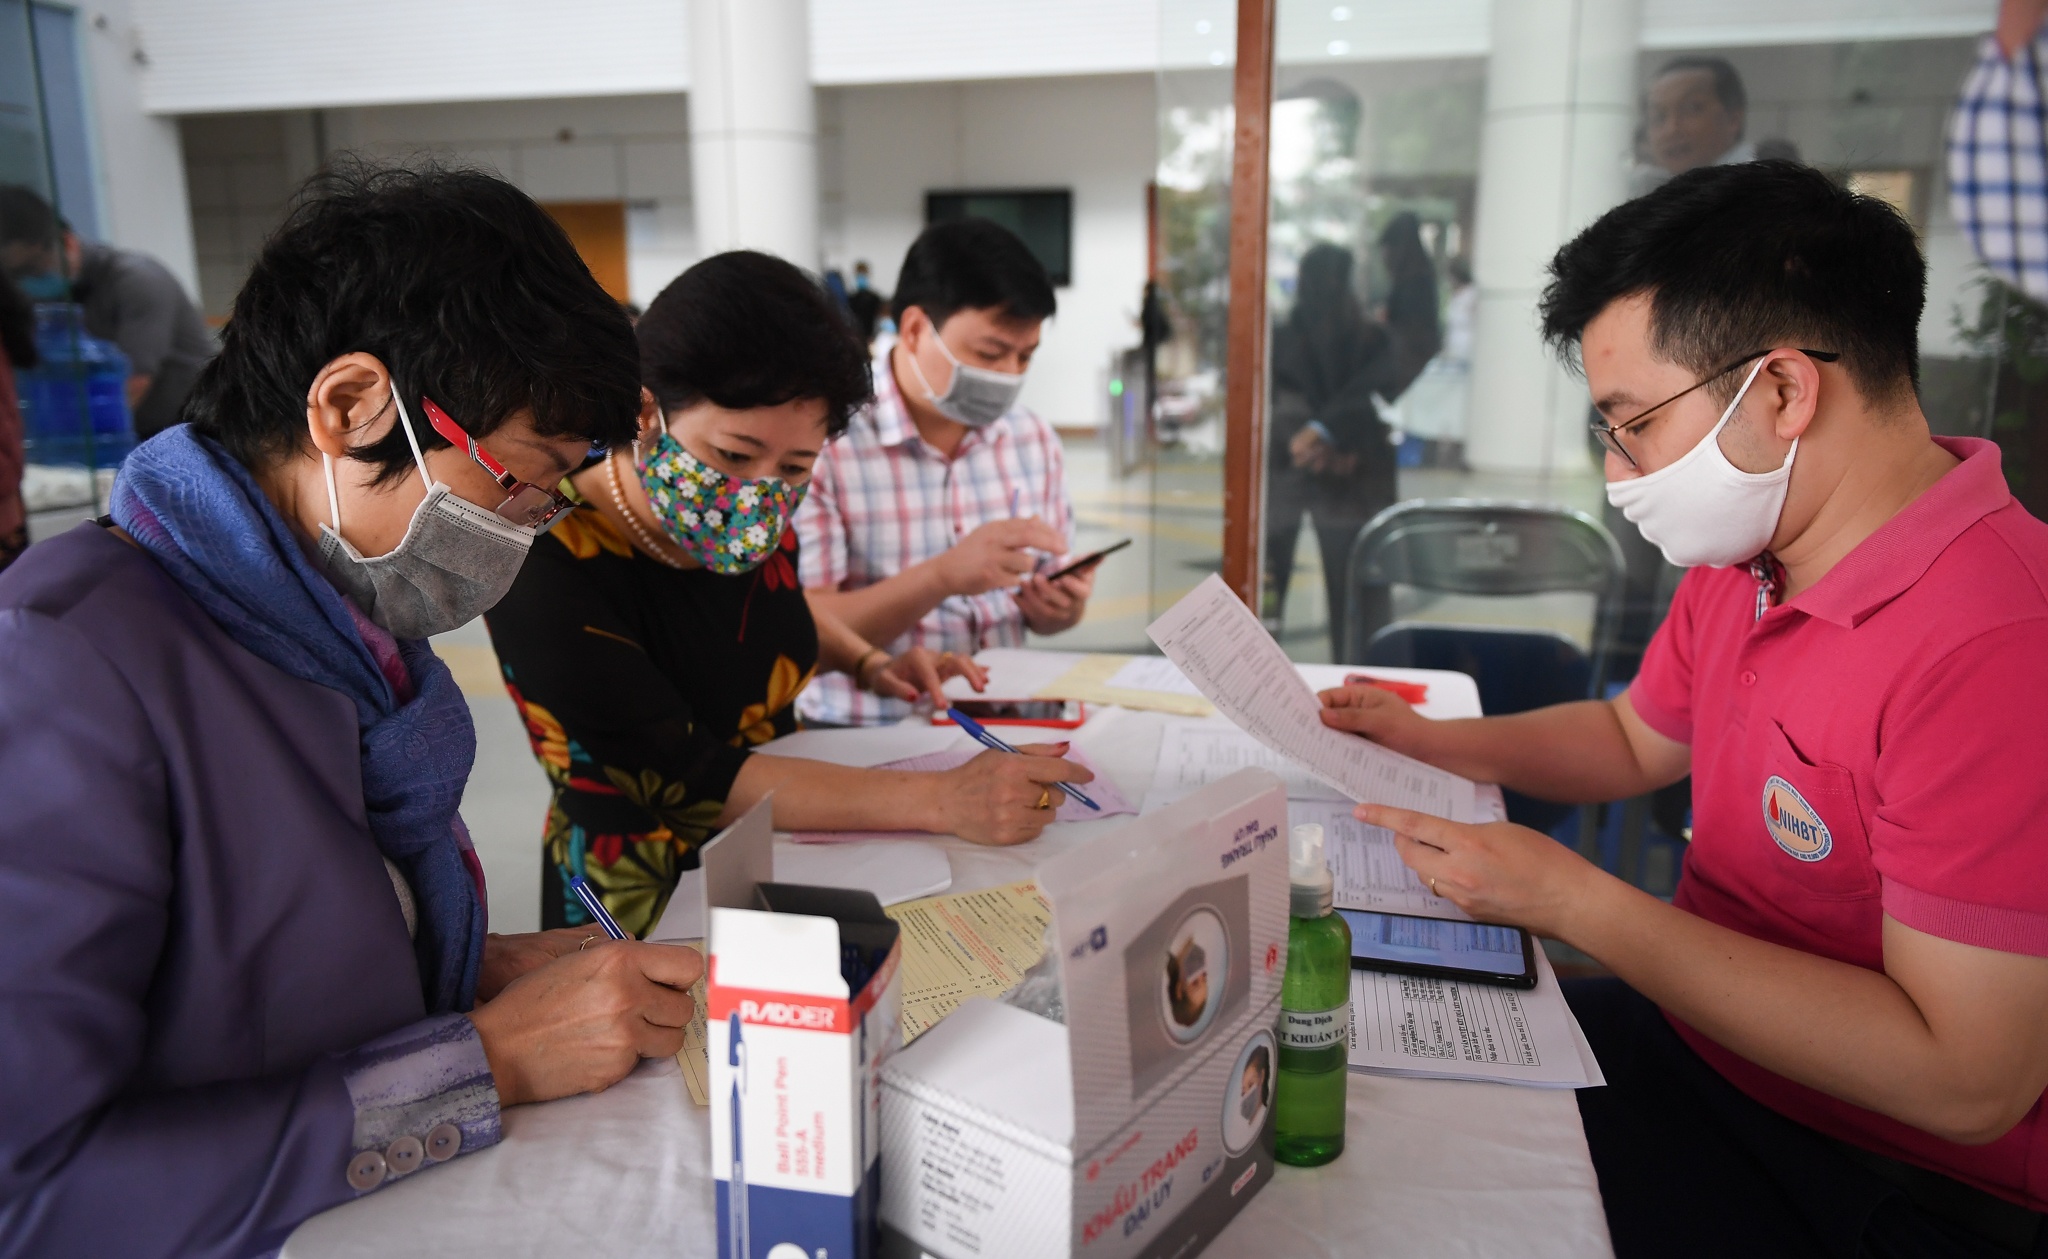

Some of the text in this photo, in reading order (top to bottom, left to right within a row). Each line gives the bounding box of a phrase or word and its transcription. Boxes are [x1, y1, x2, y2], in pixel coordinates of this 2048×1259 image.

[1779, 806, 1818, 845] NIHBT
[740, 999, 835, 1029] RADDER
[1288, 1015, 1333, 1026] Dung Dịch
[774, 1056, 789, 1087] Pen
[774, 1094, 789, 1138] Point
[811, 1111, 826, 1180] medium
[1140, 1127, 1198, 1195] TRANG
